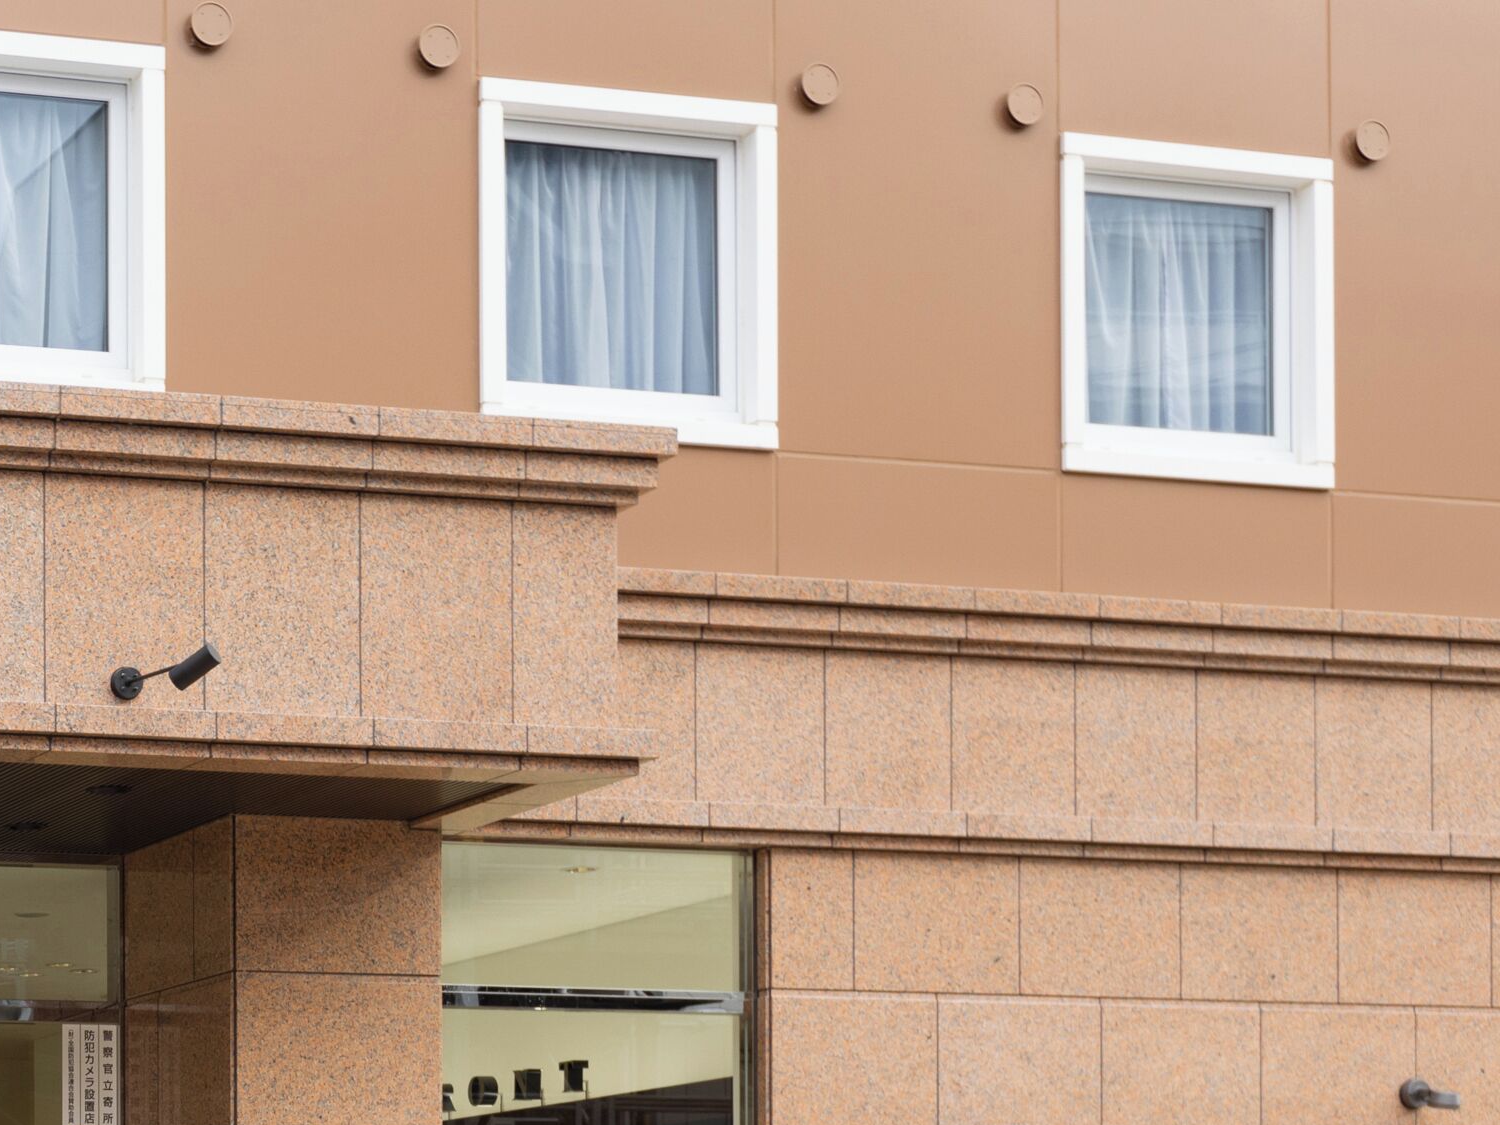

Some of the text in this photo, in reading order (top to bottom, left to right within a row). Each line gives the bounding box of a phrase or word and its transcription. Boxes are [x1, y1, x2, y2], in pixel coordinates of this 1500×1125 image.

[84, 1030, 96, 1124] 防犯カメラ設置店
[102, 1030, 113, 1124] 警察官立寄所
